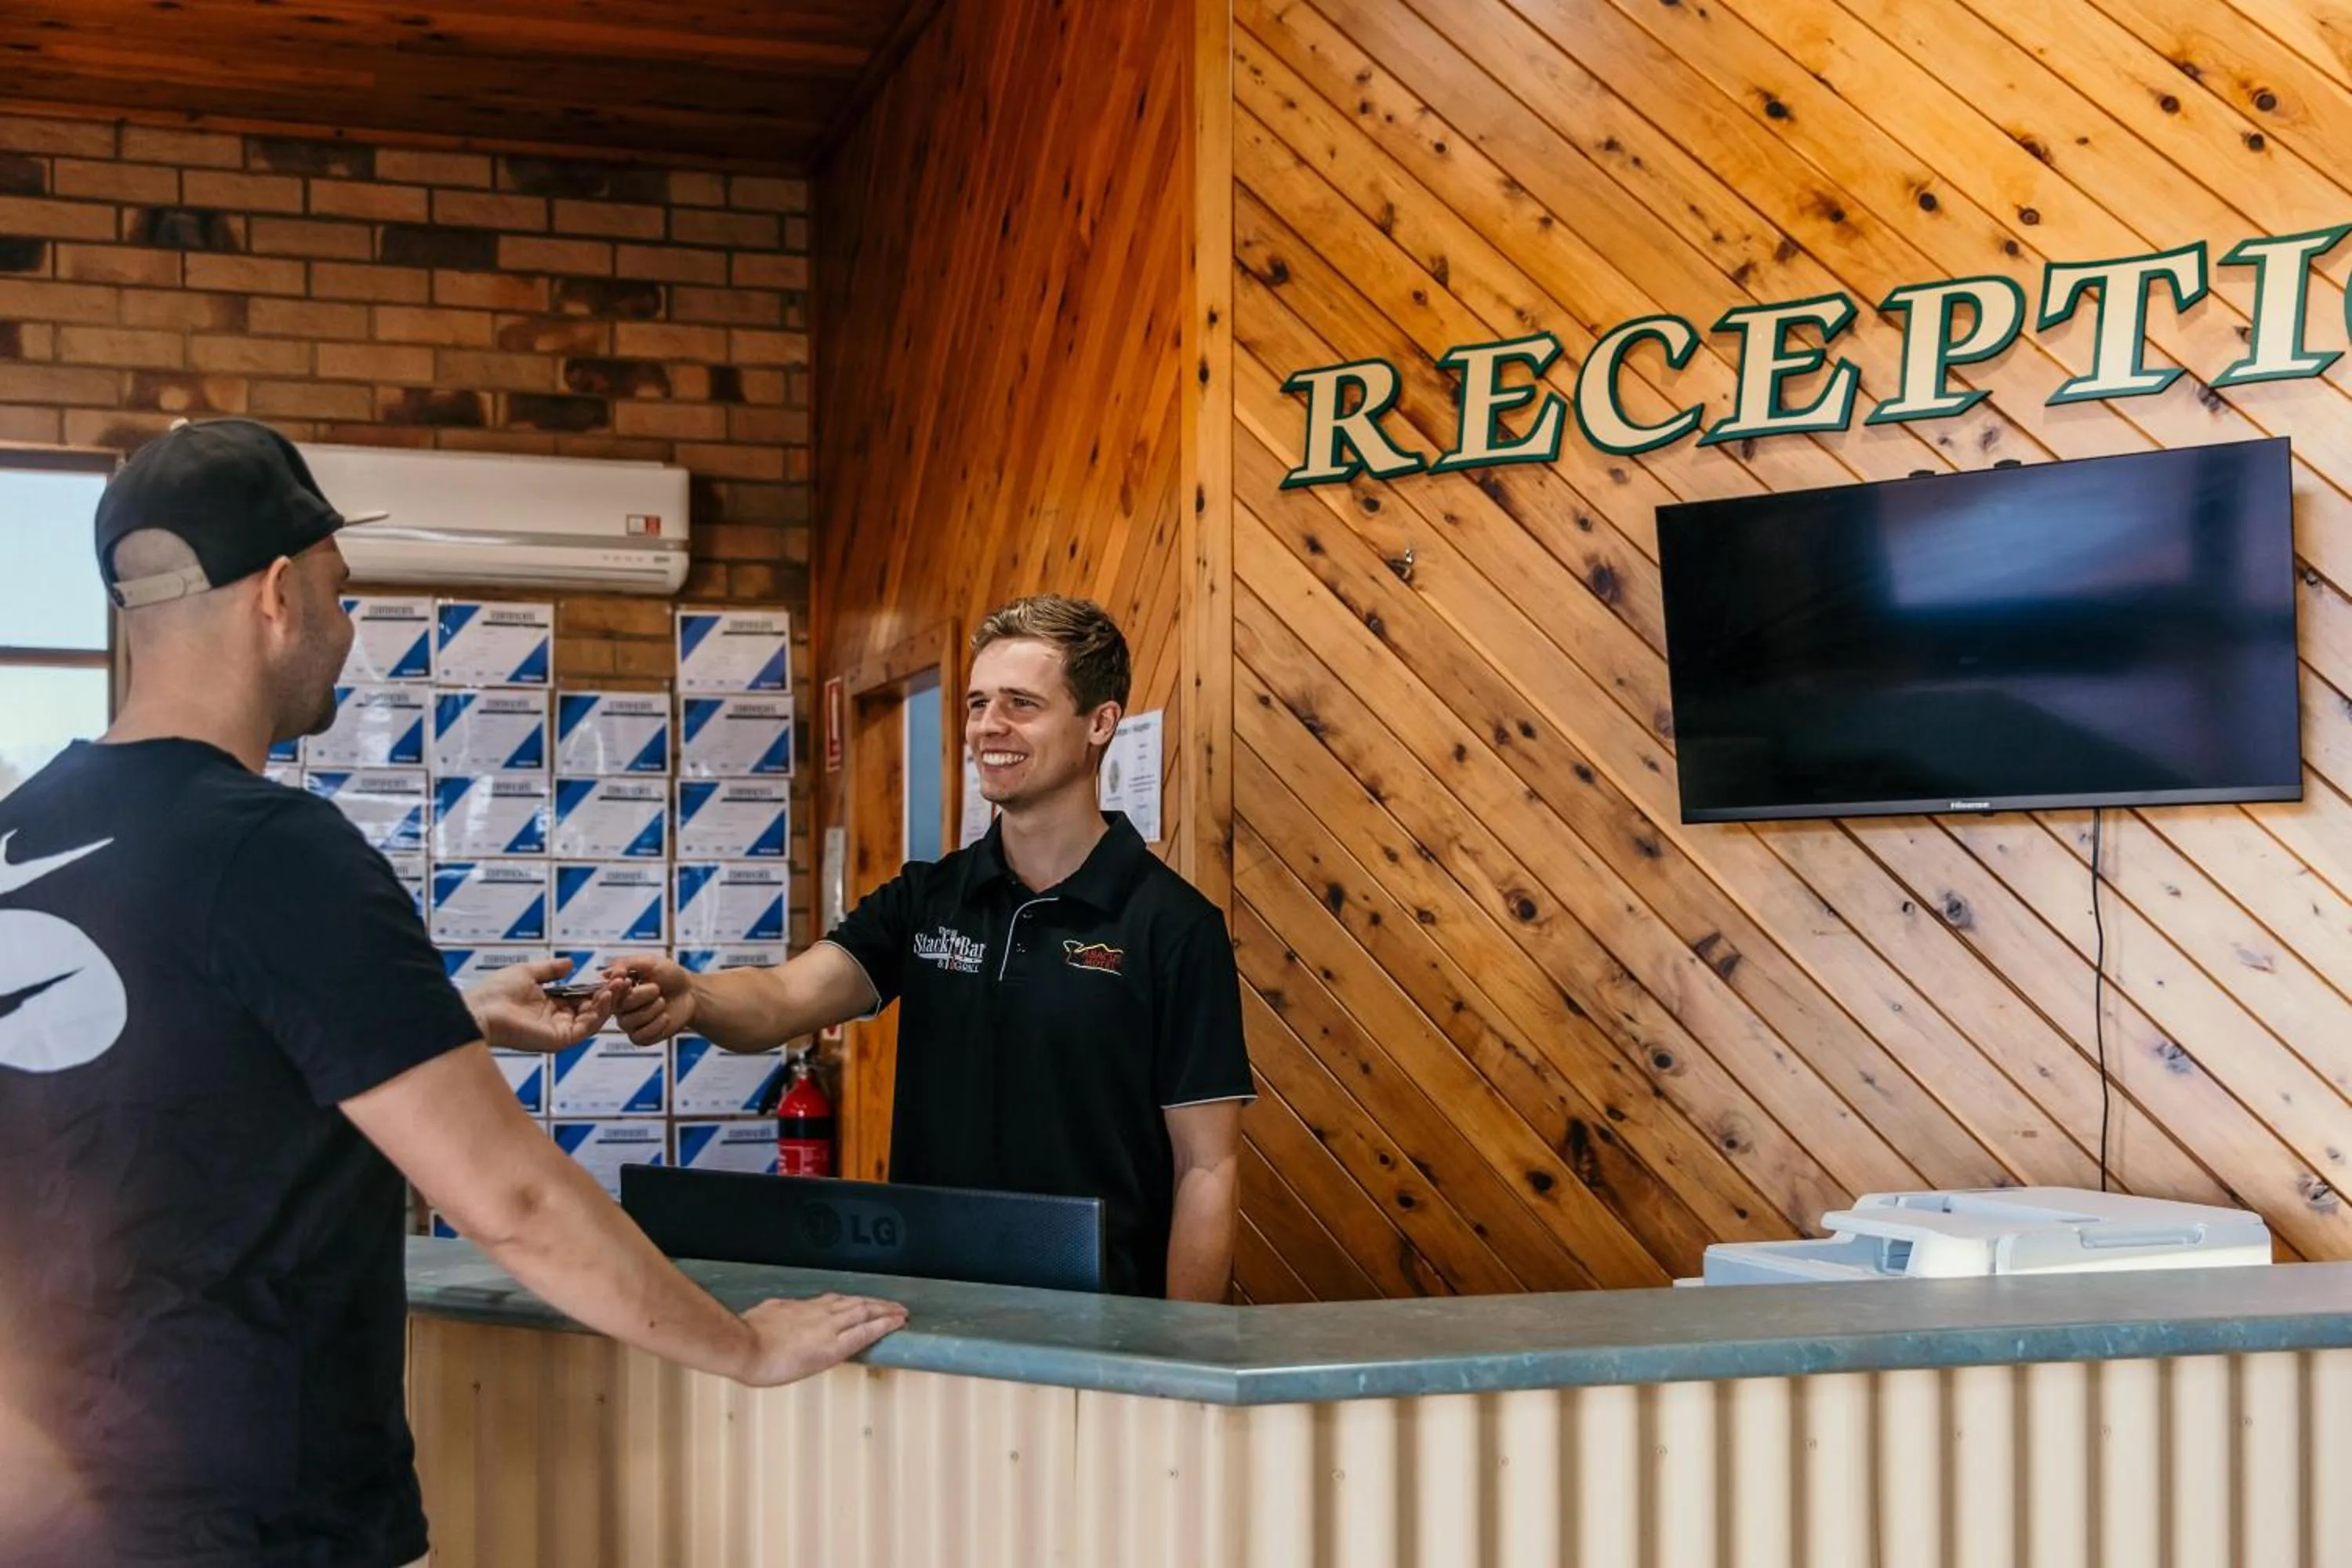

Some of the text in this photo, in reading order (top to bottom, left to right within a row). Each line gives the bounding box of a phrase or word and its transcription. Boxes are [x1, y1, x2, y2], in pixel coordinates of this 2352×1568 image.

[1279, 223, 2352, 490] RECEPTI
[960, 935, 986, 958] Bar
[851, 1214, 897, 1247] LG
